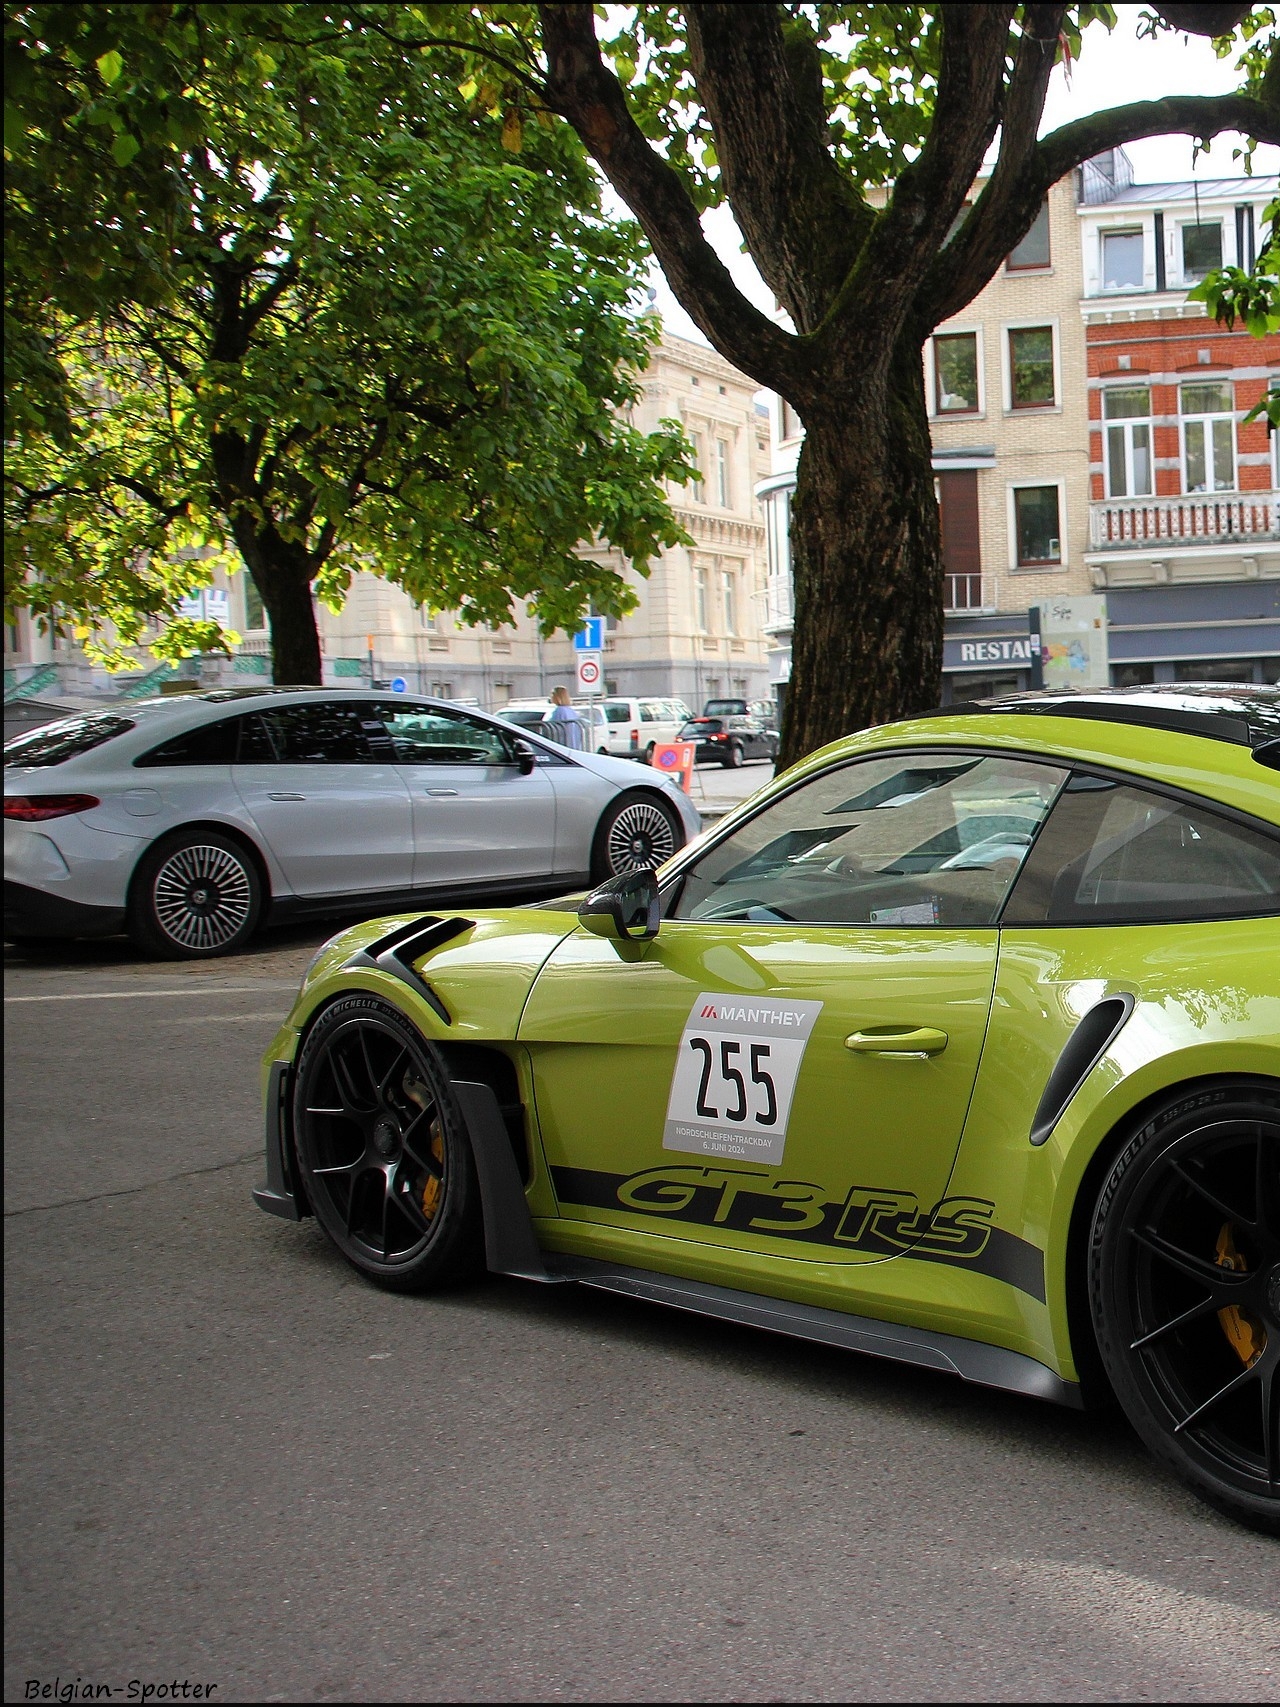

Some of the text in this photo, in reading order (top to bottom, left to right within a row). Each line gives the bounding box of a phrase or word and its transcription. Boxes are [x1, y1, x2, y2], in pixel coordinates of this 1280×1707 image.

[333, 1000, 379, 1016] MICHELIN
[720, 1006, 806, 1027] MANTHEY
[689, 1037, 779, 1127] 255
[675, 1127, 773, 1149] NORDSCHLEIFEN-TRACKDAY
[711, 1143, 727, 1152] JUNI
[728, 1144, 746, 1155] 2024
